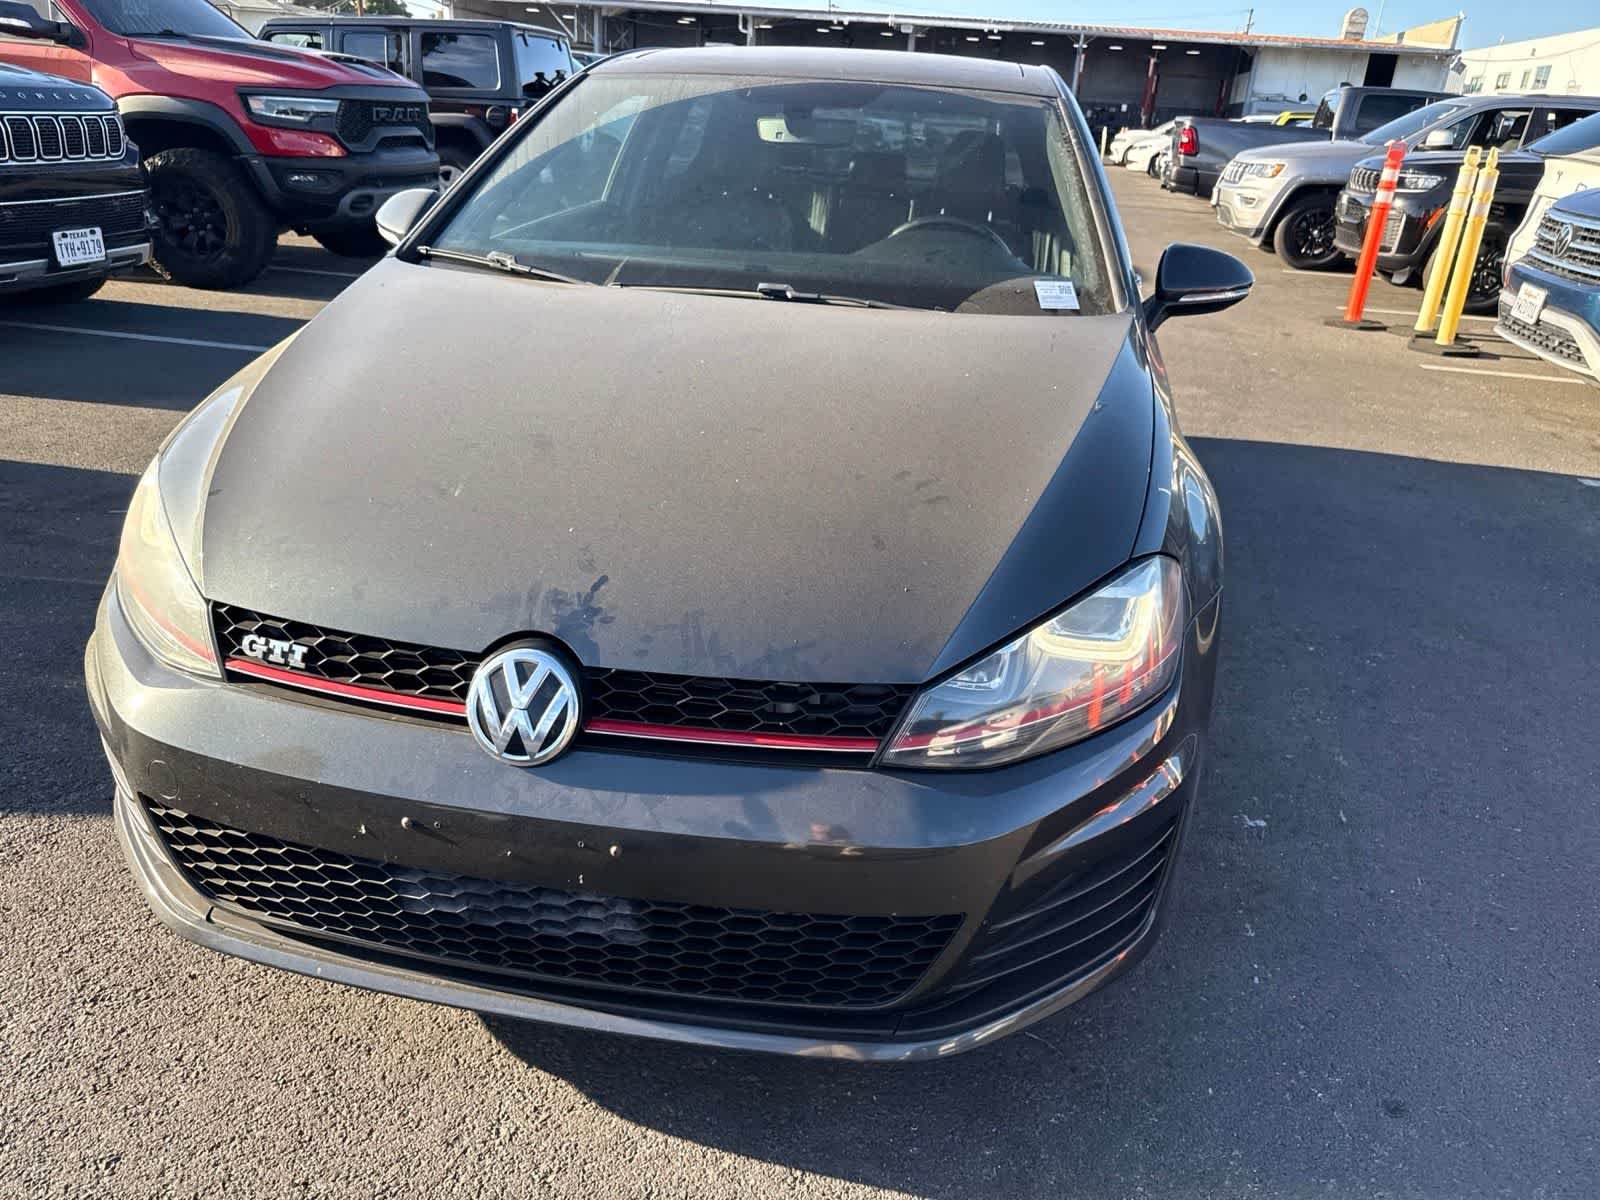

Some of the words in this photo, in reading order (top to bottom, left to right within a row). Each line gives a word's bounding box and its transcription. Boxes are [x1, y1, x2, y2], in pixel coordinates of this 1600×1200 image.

[372, 106, 420, 121] RAM
[69, 231, 88, 239] TEXAS
[241, 634, 309, 669] GTI
